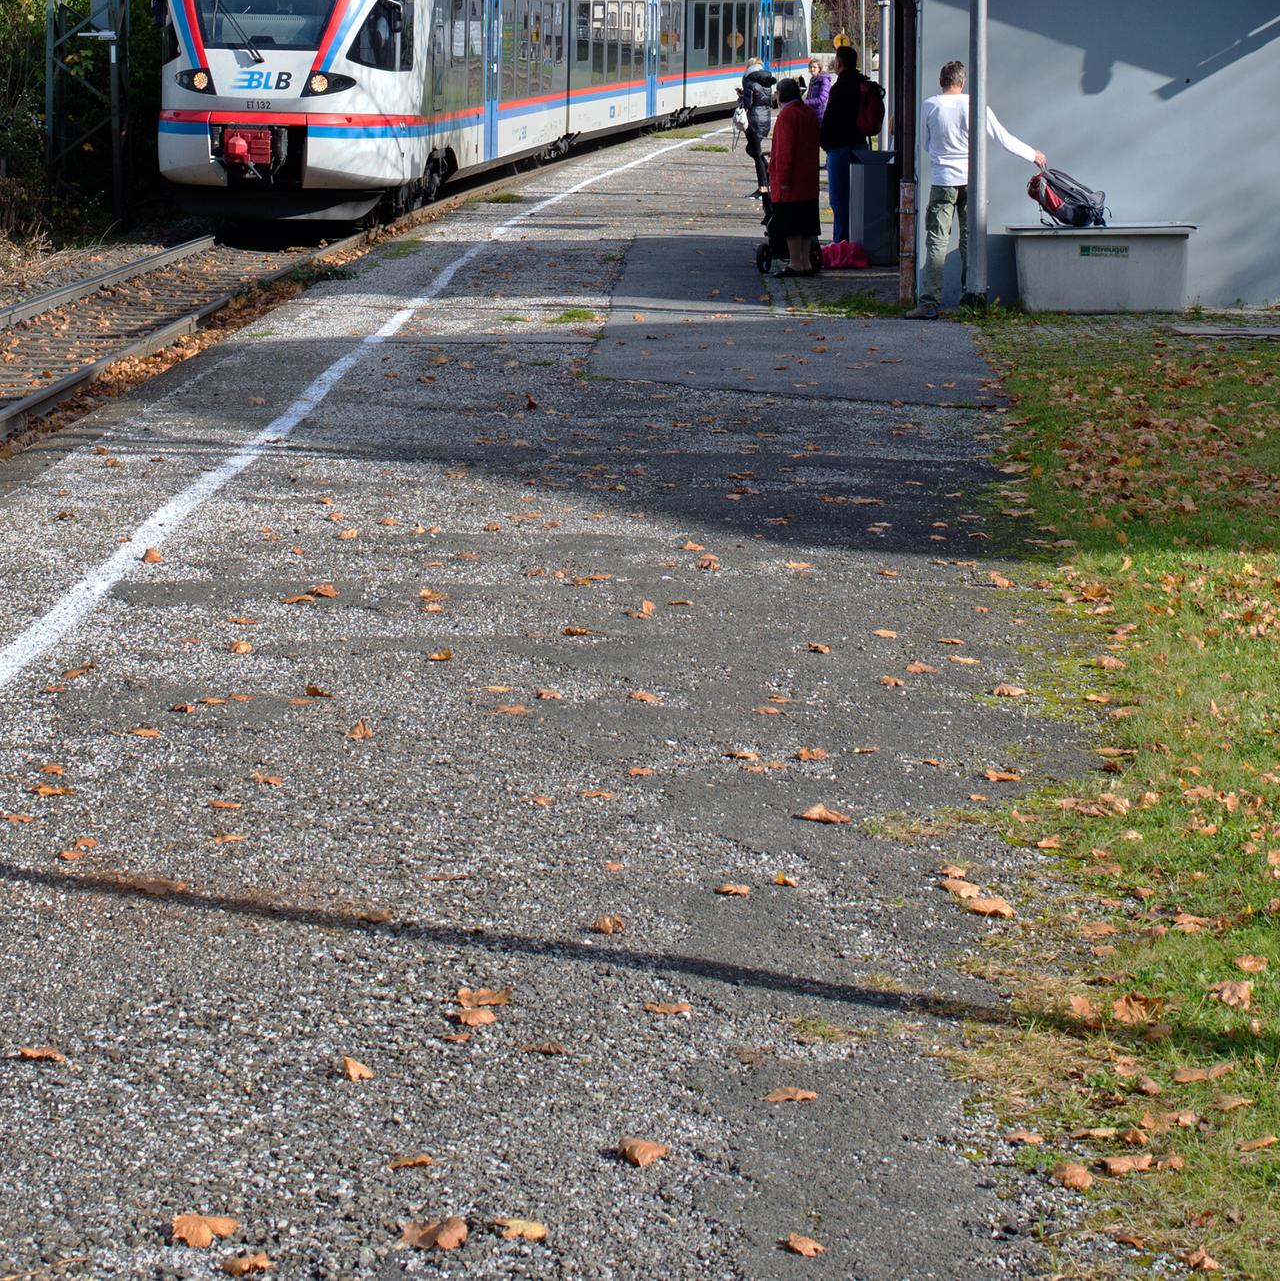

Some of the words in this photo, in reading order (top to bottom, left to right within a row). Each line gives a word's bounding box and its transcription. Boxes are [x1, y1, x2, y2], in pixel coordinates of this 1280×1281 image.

[235, 71, 292, 90] BLB
[246, 101, 255, 109] ET
[256, 101, 271, 109] 132
